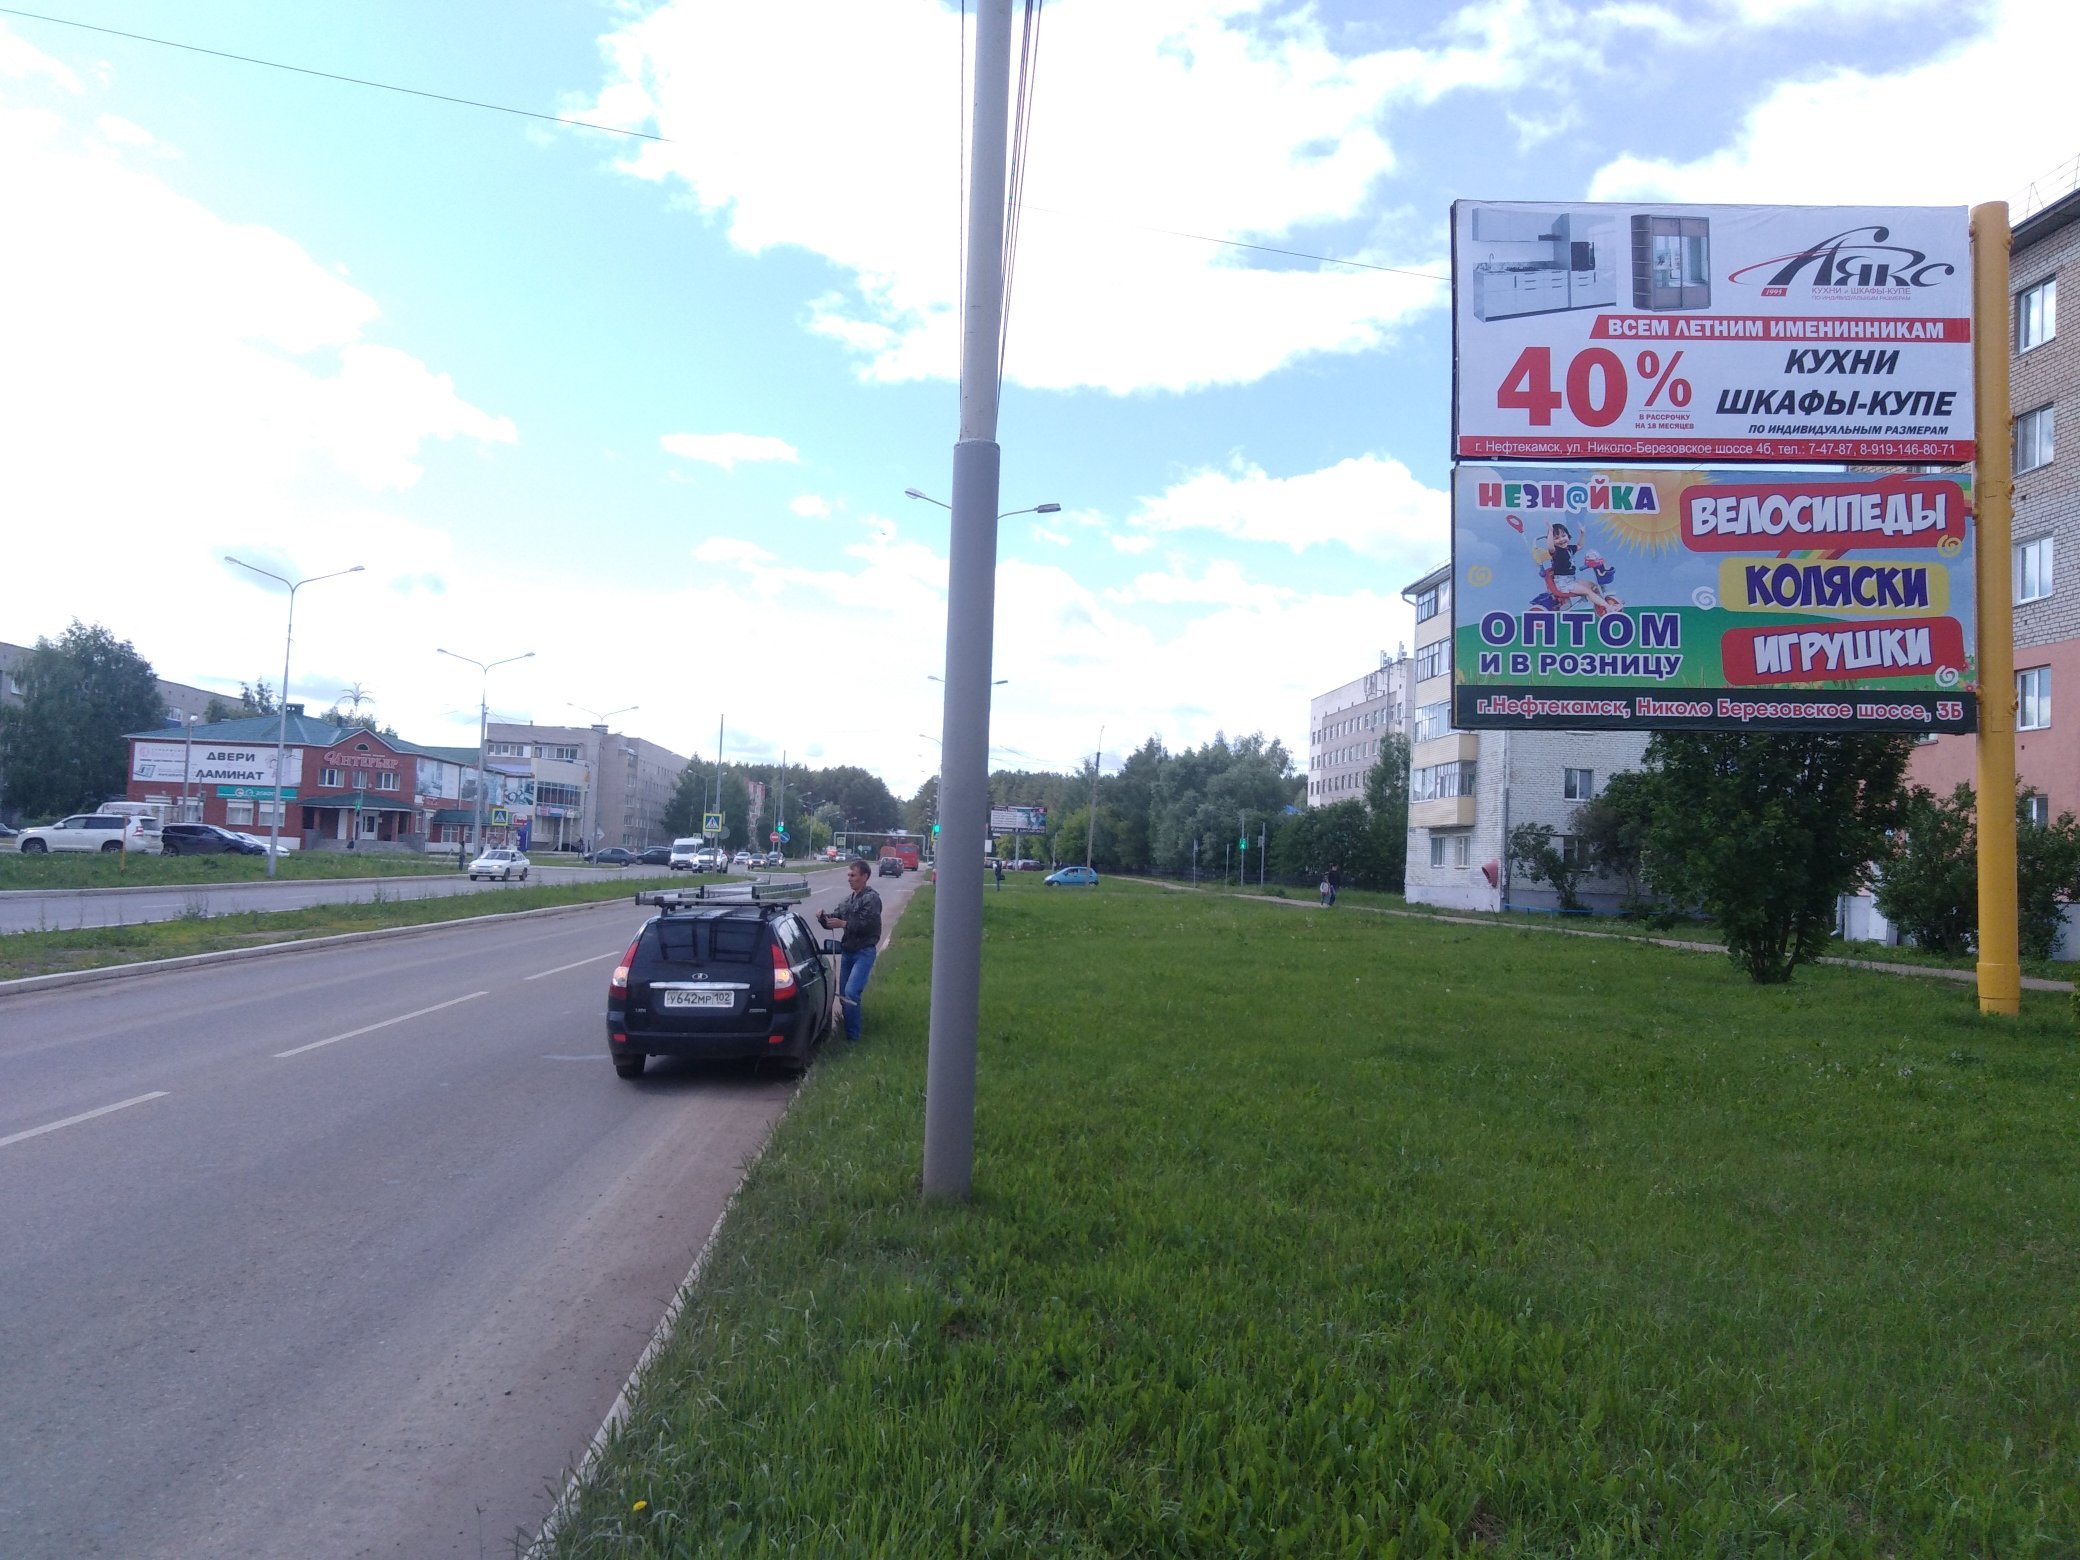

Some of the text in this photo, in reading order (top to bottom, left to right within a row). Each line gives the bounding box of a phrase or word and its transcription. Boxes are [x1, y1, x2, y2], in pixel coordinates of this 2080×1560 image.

[1765, 288, 1783, 296] 1995
[1850, 287, 1911, 295] ШКАФЫ-КУПЕ
[1608, 319, 1944, 339] ВСЕМ ЛЕТНИМ ИМЕНИННИКАМ
[1784, 349, 1900, 375] КУХНИ
[1497, 346, 1692, 428] 40%
[1715, 389, 1957, 417] ШКАФЫ-КУПЕ
[1748, 424, 1949, 436] ПО ИНДИВИДУАЛЬНЫМ РАЗМЕРАМ
[1475, 443, 1481, 452] г.
[1485, 441, 1563, 454] Нефтекамск,
[1566, 443, 1583, 456] ул.
[1588, 441, 1712, 455] Николо-Березовское
[1716, 445, 1753, 455] шоссе
[1809, 443, 1857, 457] 7-47-87,
[1860, 444, 1955, 456] 8-919-146-80-71
[1478, 477, 1656, 511] НЕЗН@ЙКА
[1690, 492, 1947, 537] ВЕЛОСИПЕДЫ
[1745, 563, 1930, 608] КОЛЯСКИ
[1480, 611, 1681, 648] ОПТОМ
[1753, 627, 1932, 676] ИГРУШКИ
[1480, 653, 1682, 680] И В РОЗНИЦУ
[1477, 695, 1963, 723] г.Нефтекамск, Николо Березовское шоссе, 3Б
[206, 752, 255, 762] ДВЕРИ
[195, 769, 264, 781] ЛАМИНАТ
[714, 993, 730, 1002] 102
